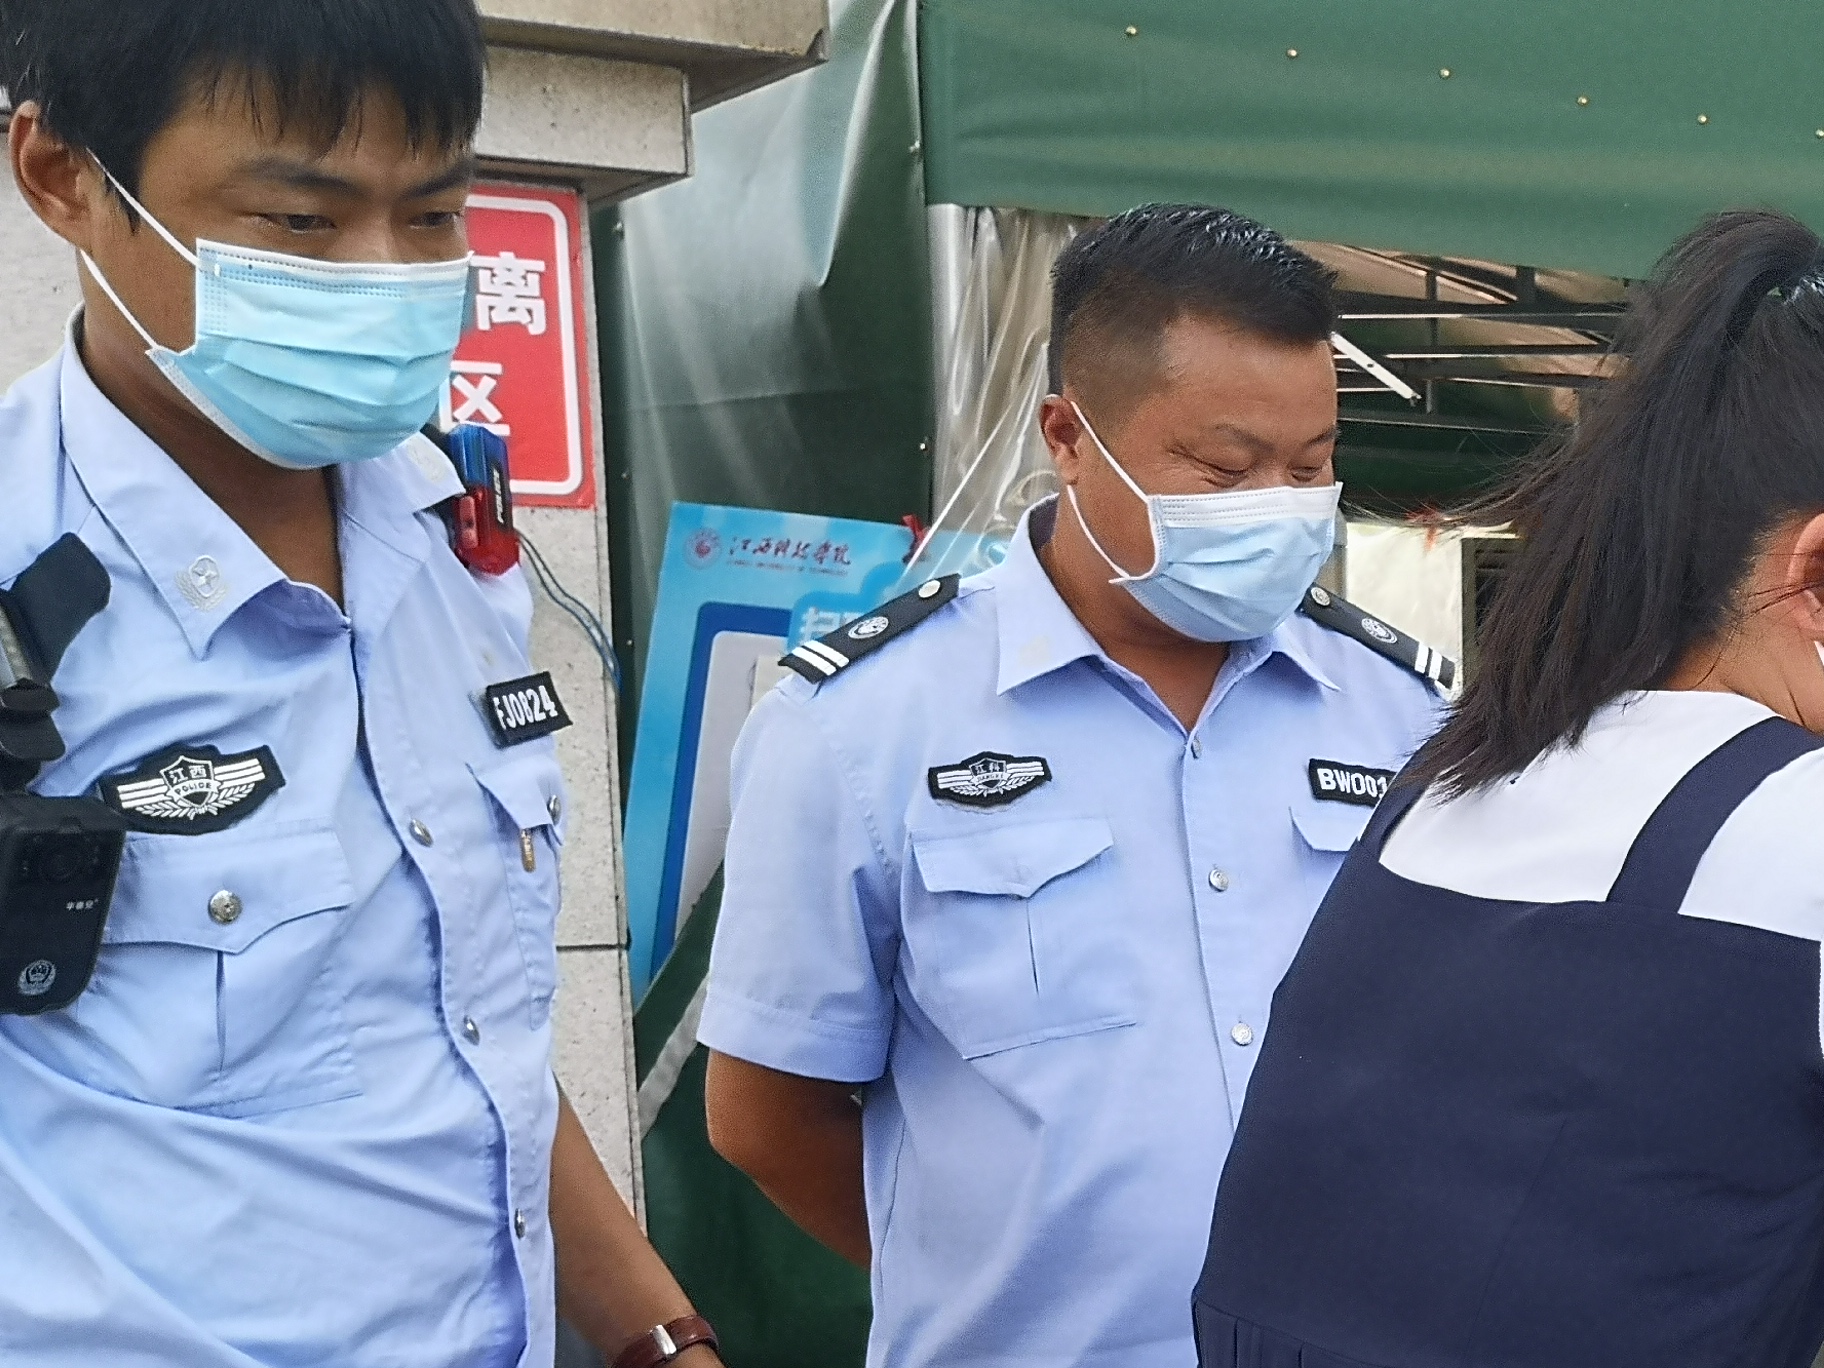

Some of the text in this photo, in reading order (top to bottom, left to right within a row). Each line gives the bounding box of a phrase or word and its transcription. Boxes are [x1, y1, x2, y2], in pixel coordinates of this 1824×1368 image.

[469, 252, 547, 336] 离
[438, 360, 511, 434] 区
[169, 764, 207, 784] 江西
[175, 781, 213, 796] POLICE
